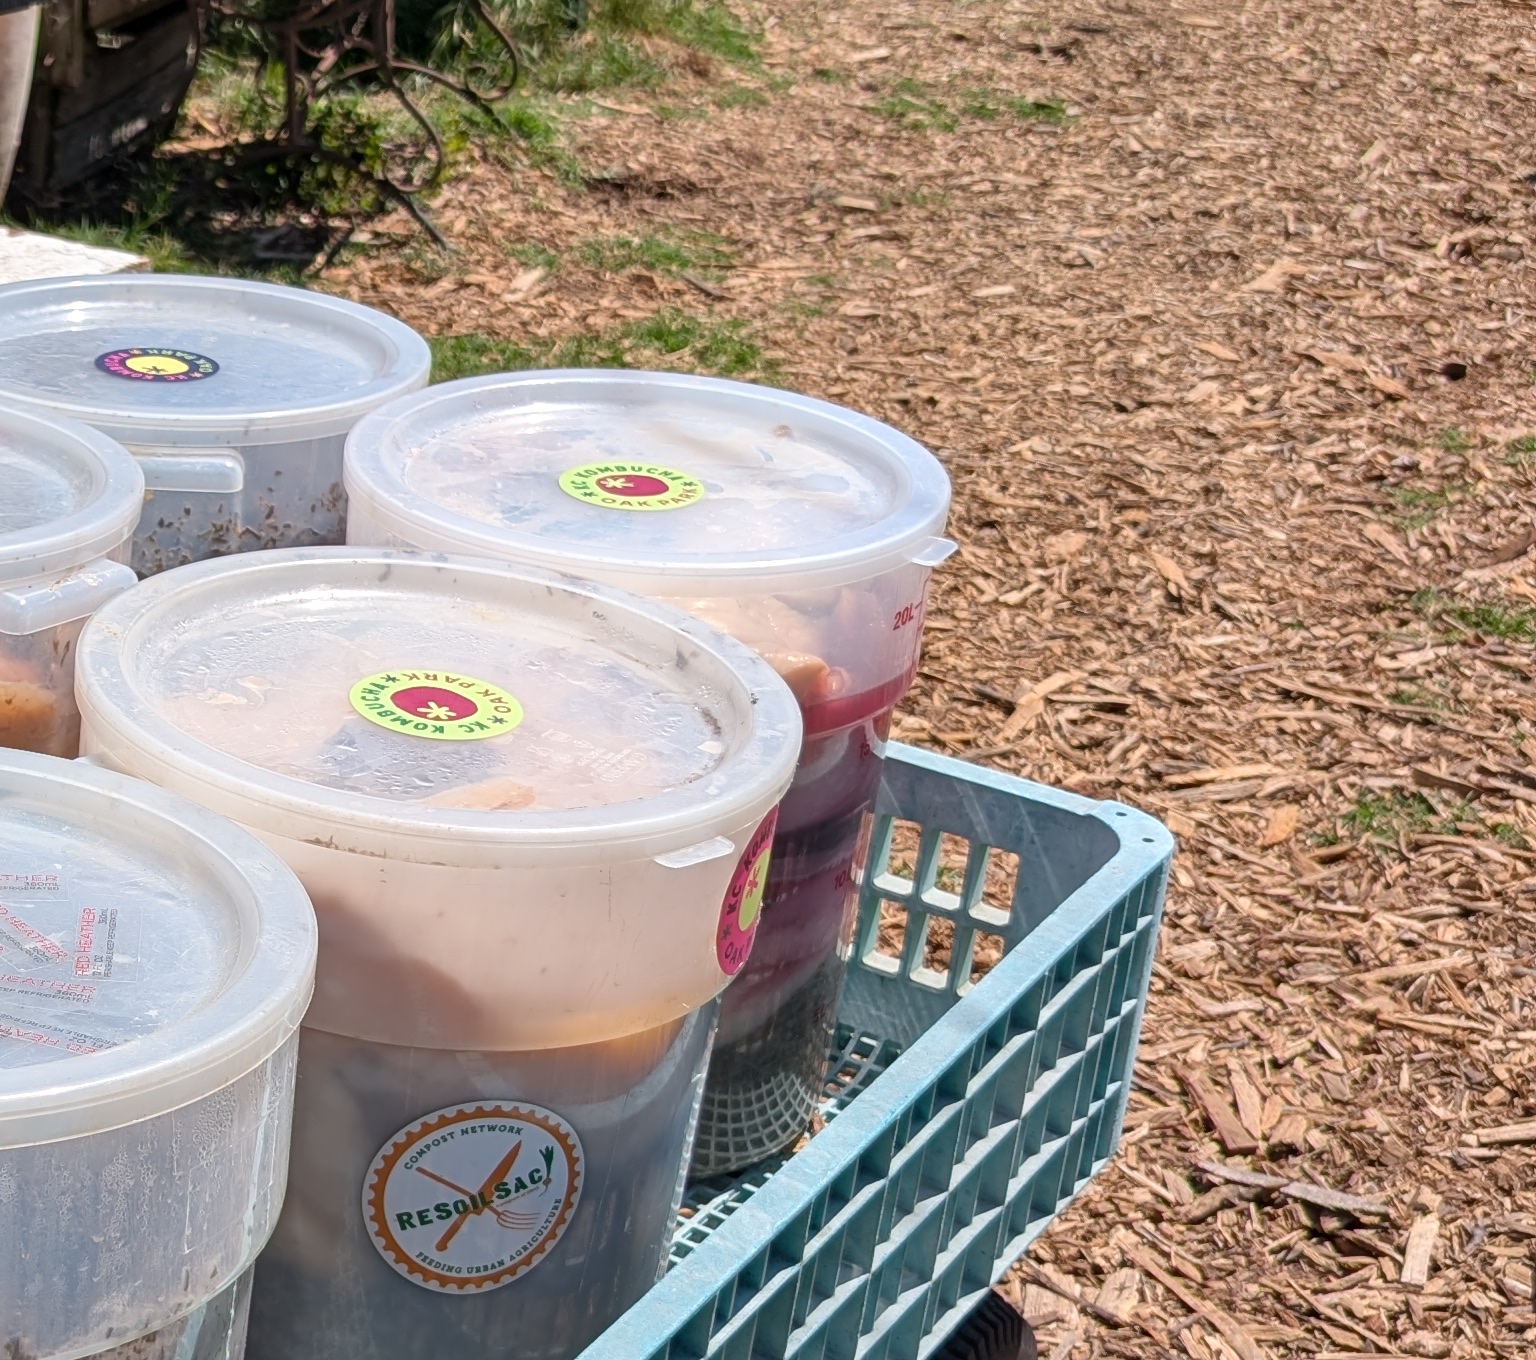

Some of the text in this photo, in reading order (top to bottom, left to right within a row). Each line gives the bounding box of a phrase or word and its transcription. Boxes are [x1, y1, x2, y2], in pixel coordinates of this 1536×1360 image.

[601, 487, 699, 507] OAK PARK
[892, 602, 914, 631] 20L
[360, 682, 491, 734] KC KOMBUCHA
[401, 672, 512, 714] OAK PARK
[726, 884, 742, 916] KC
[3, 915, 71, 959] HEATHER
[74, 907, 97, 976] RED HEATHER
[724, 941, 743, 964] OAK
[17, 989, 90, 1003] REFRIGERATED
[37, 1023, 65, 1032] KEEP
[403, 1124, 524, 1170] COMPOST NETWORK
[415, 1197, 562, 1274] FEEDING URBAN AGRICULTURE
